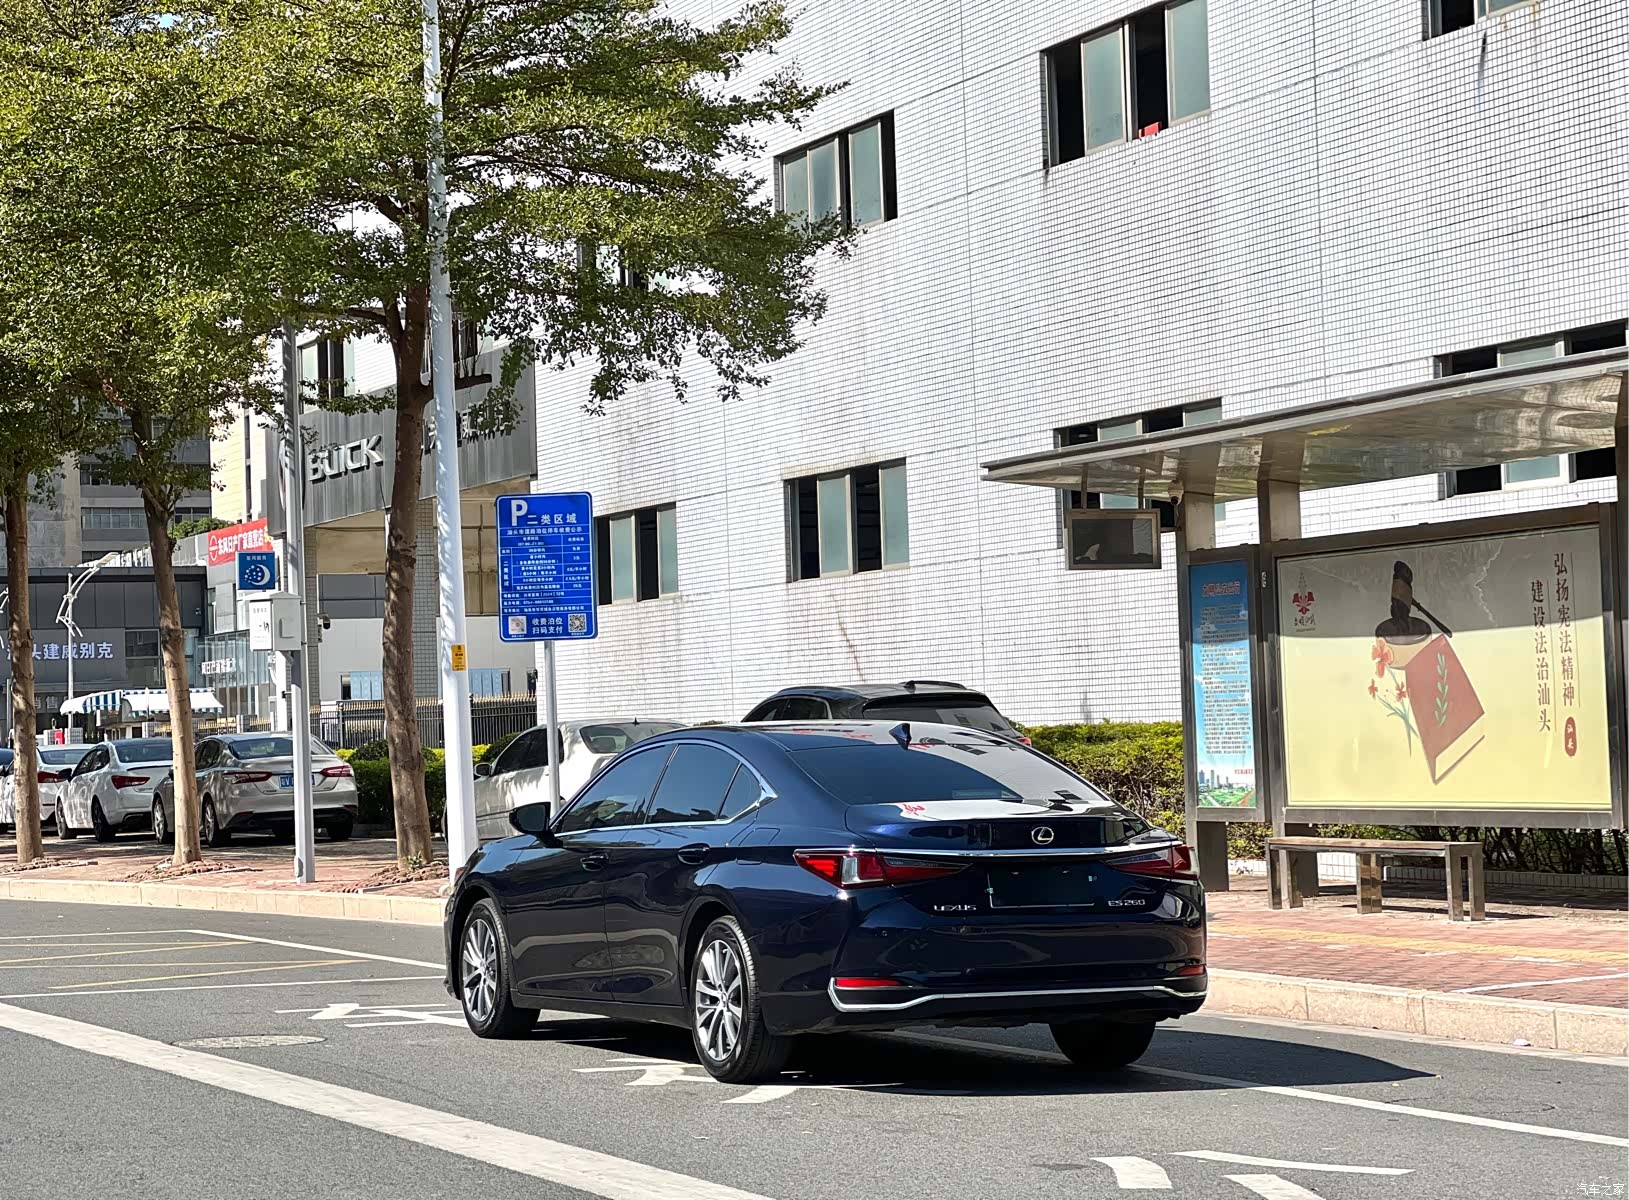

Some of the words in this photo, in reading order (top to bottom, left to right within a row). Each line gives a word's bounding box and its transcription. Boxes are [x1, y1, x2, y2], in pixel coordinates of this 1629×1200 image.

[308, 434, 384, 482] BUICK
[511, 499, 528, 527] P
[527, 513, 577, 525] 二类区域
[217, 529, 264, 556] 东风日产厂家直营店
[531, 617, 564, 626] 收费泊位
[532, 626, 564, 635] 扫码支付
[1554, 552, 1575, 707] 弘扬宪法精神
[7, 641, 114, 660] 头建威别克
[1531, 579, 1552, 732] 建设法治汕头
[1107, 899, 1124, 907] ES
